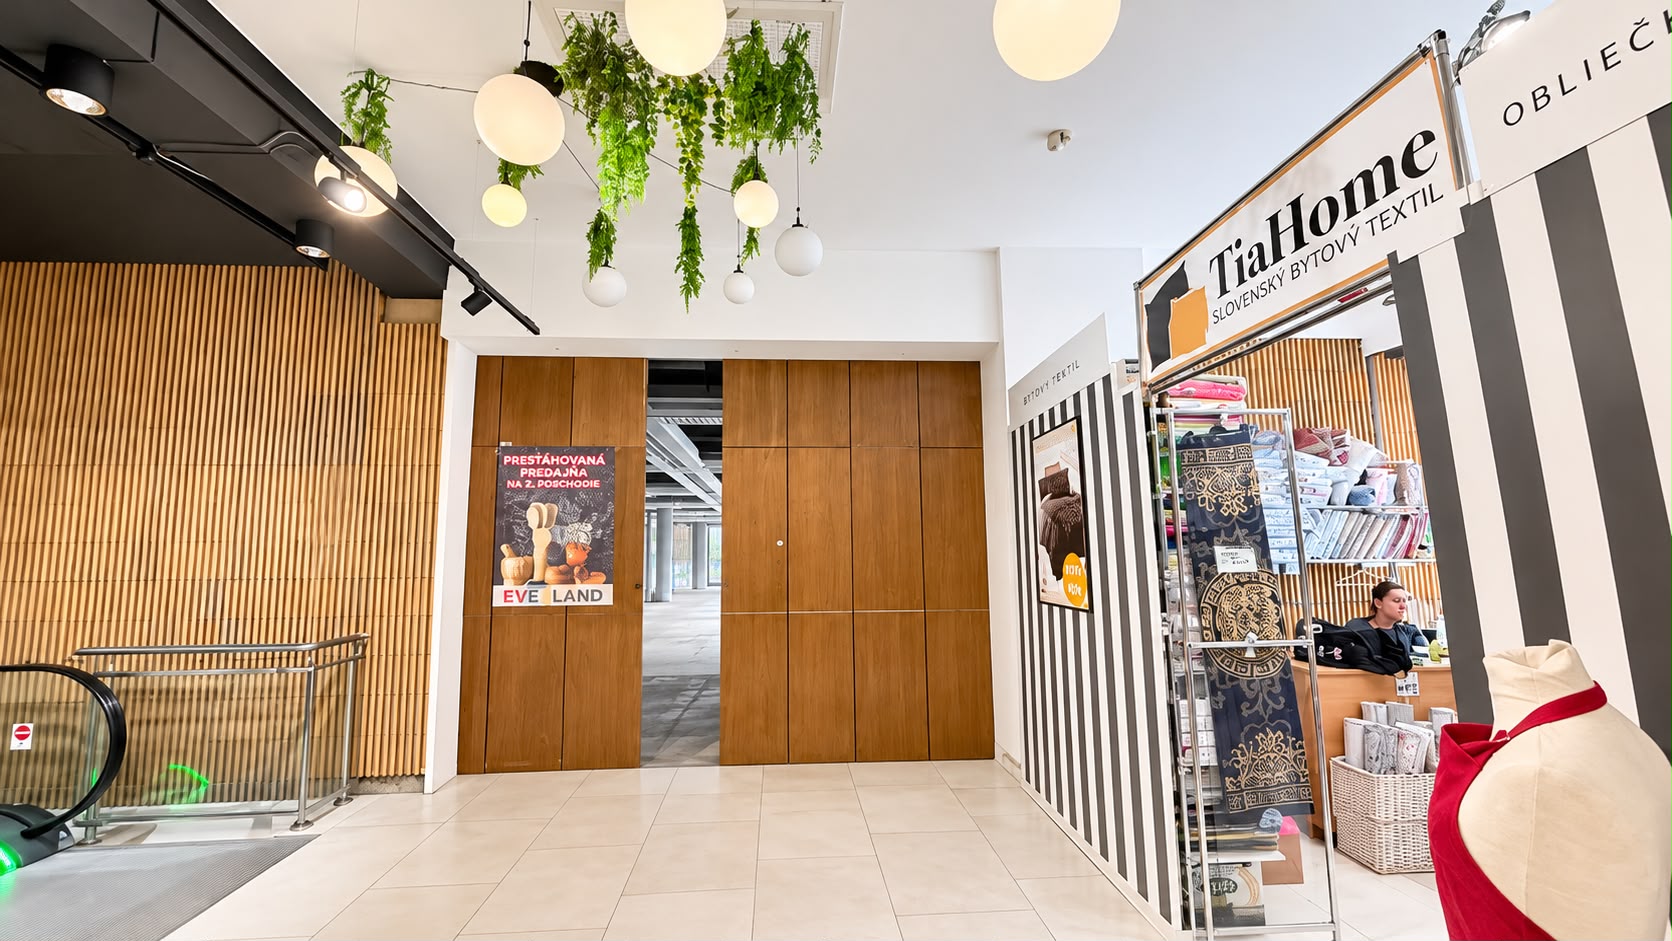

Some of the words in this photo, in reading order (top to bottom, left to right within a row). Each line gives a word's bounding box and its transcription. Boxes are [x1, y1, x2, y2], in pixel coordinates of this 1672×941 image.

[1209, 130, 1438, 299] TiaHome
[1212, 267, 1285, 324] SLOVENSKÝ
[1290, 223, 1360, 281] BYTOVÝ
[1365, 183, 1444, 236] TEXTIL
[1052, 360, 1080, 385] TEXTIL
[520, 465, 588, 477] PREDAJŇA
[506, 480, 523, 489] NA
[525, 480, 535, 489] 2.
[537, 480, 600, 489] POSCHODIE
